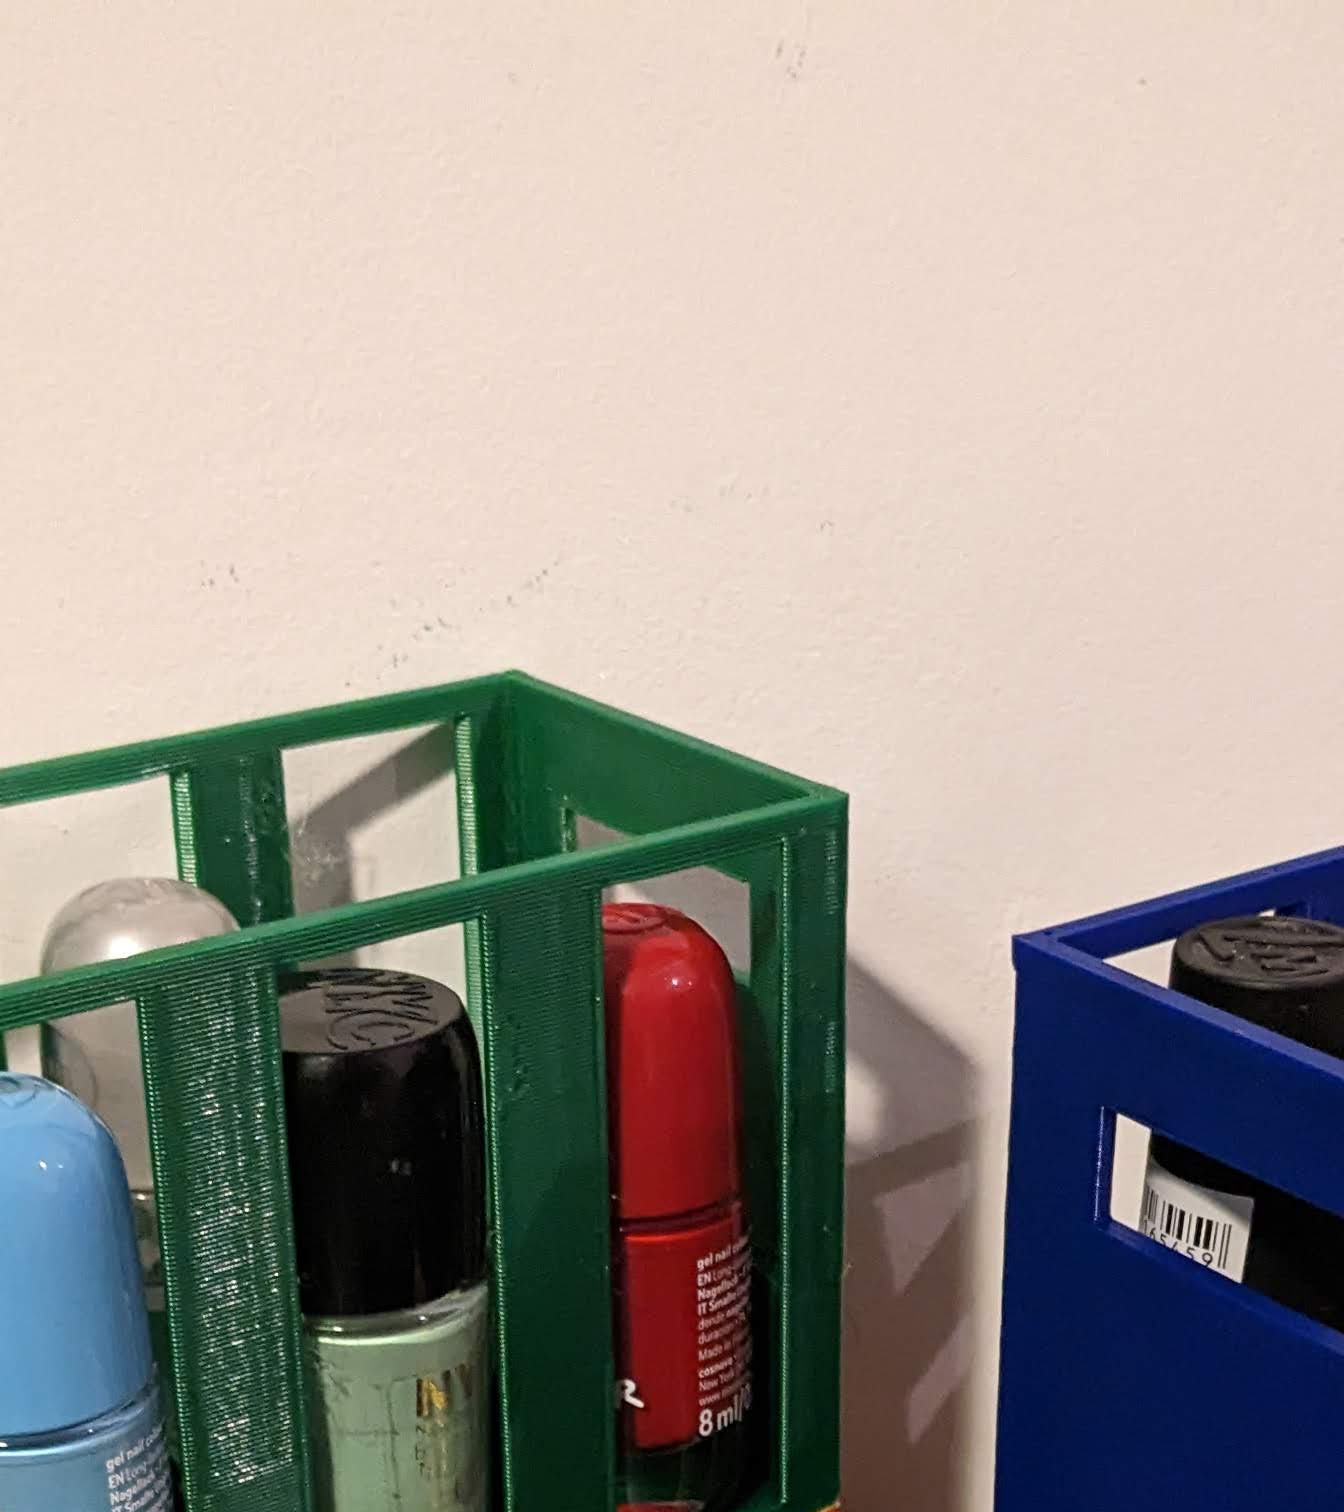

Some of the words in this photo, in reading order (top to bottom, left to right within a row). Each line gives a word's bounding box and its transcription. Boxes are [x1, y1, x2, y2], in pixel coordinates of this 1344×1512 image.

[697, 1252, 714, 1272] gel
[697, 1271, 712, 1287] EN
[699, 1408, 714, 1437] 8
[106, 1451, 125, 1473] gel
[108, 1471, 125, 1489] EN
